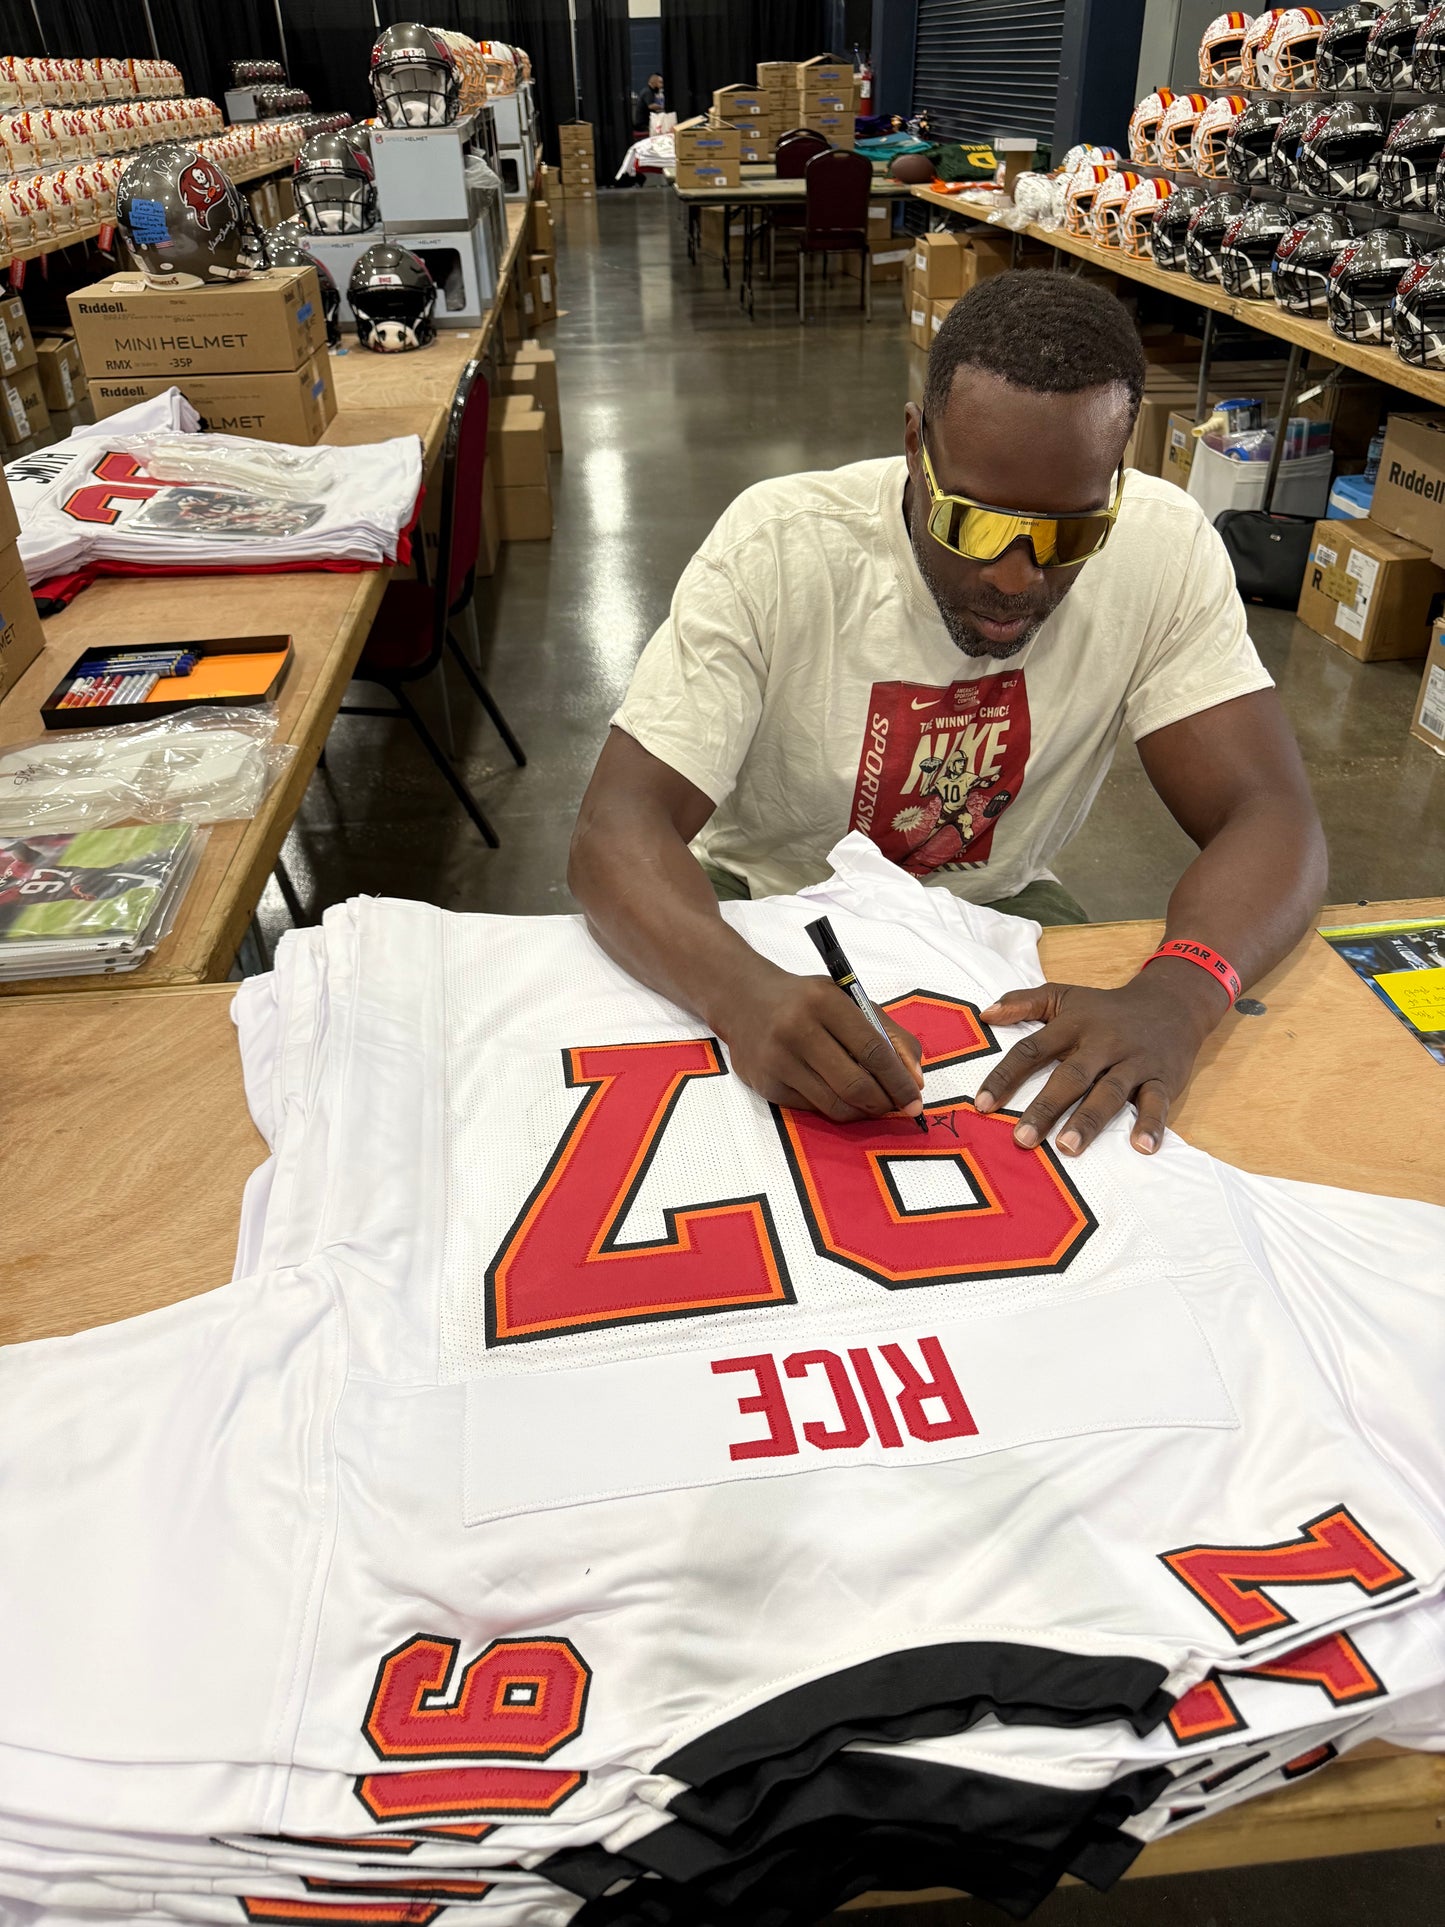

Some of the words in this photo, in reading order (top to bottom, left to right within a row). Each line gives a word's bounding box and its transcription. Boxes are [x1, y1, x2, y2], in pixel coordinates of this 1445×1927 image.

[106, 360, 133, 370] RMX
[209, 415, 265, 431] LMET
[6, 453, 78, 484] SMITH
[1388, 461, 1445, 505] Riddell
[900, 719, 1011, 795] NIKE
[856, 712, 890, 837] SPORTSW
[944, 784, 961, 803] 10
[19, 868, 74, 895] 97
[1172, 943, 1211, 961] STAR
[1214, 960, 1228, 975] IS
[710, 1336, 979, 1462] RICE
